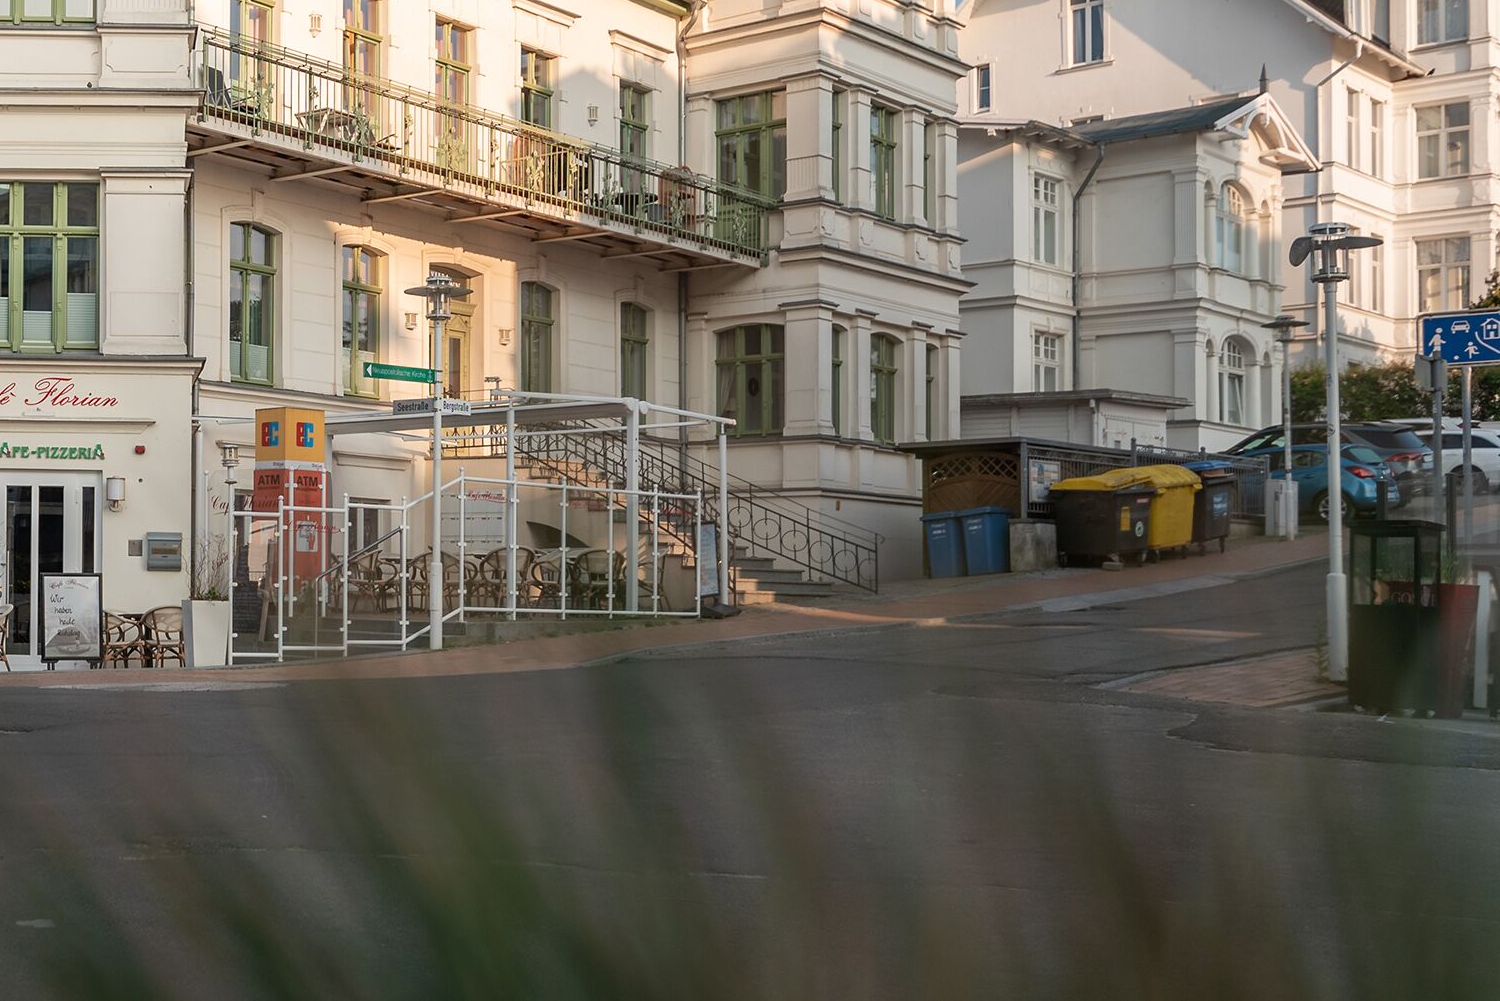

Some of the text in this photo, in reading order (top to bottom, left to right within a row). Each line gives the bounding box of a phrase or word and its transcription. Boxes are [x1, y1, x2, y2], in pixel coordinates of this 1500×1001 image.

[24, 377, 118, 407] Florian
[397, 401, 429, 412] Seestraße
[443, 400, 469, 413] Bergstraße
[258, 474, 280, 485] ATM
[296, 475, 318, 487] ATM
[211, 495, 230, 515] Caf
[50, 594, 64, 603] Wir
